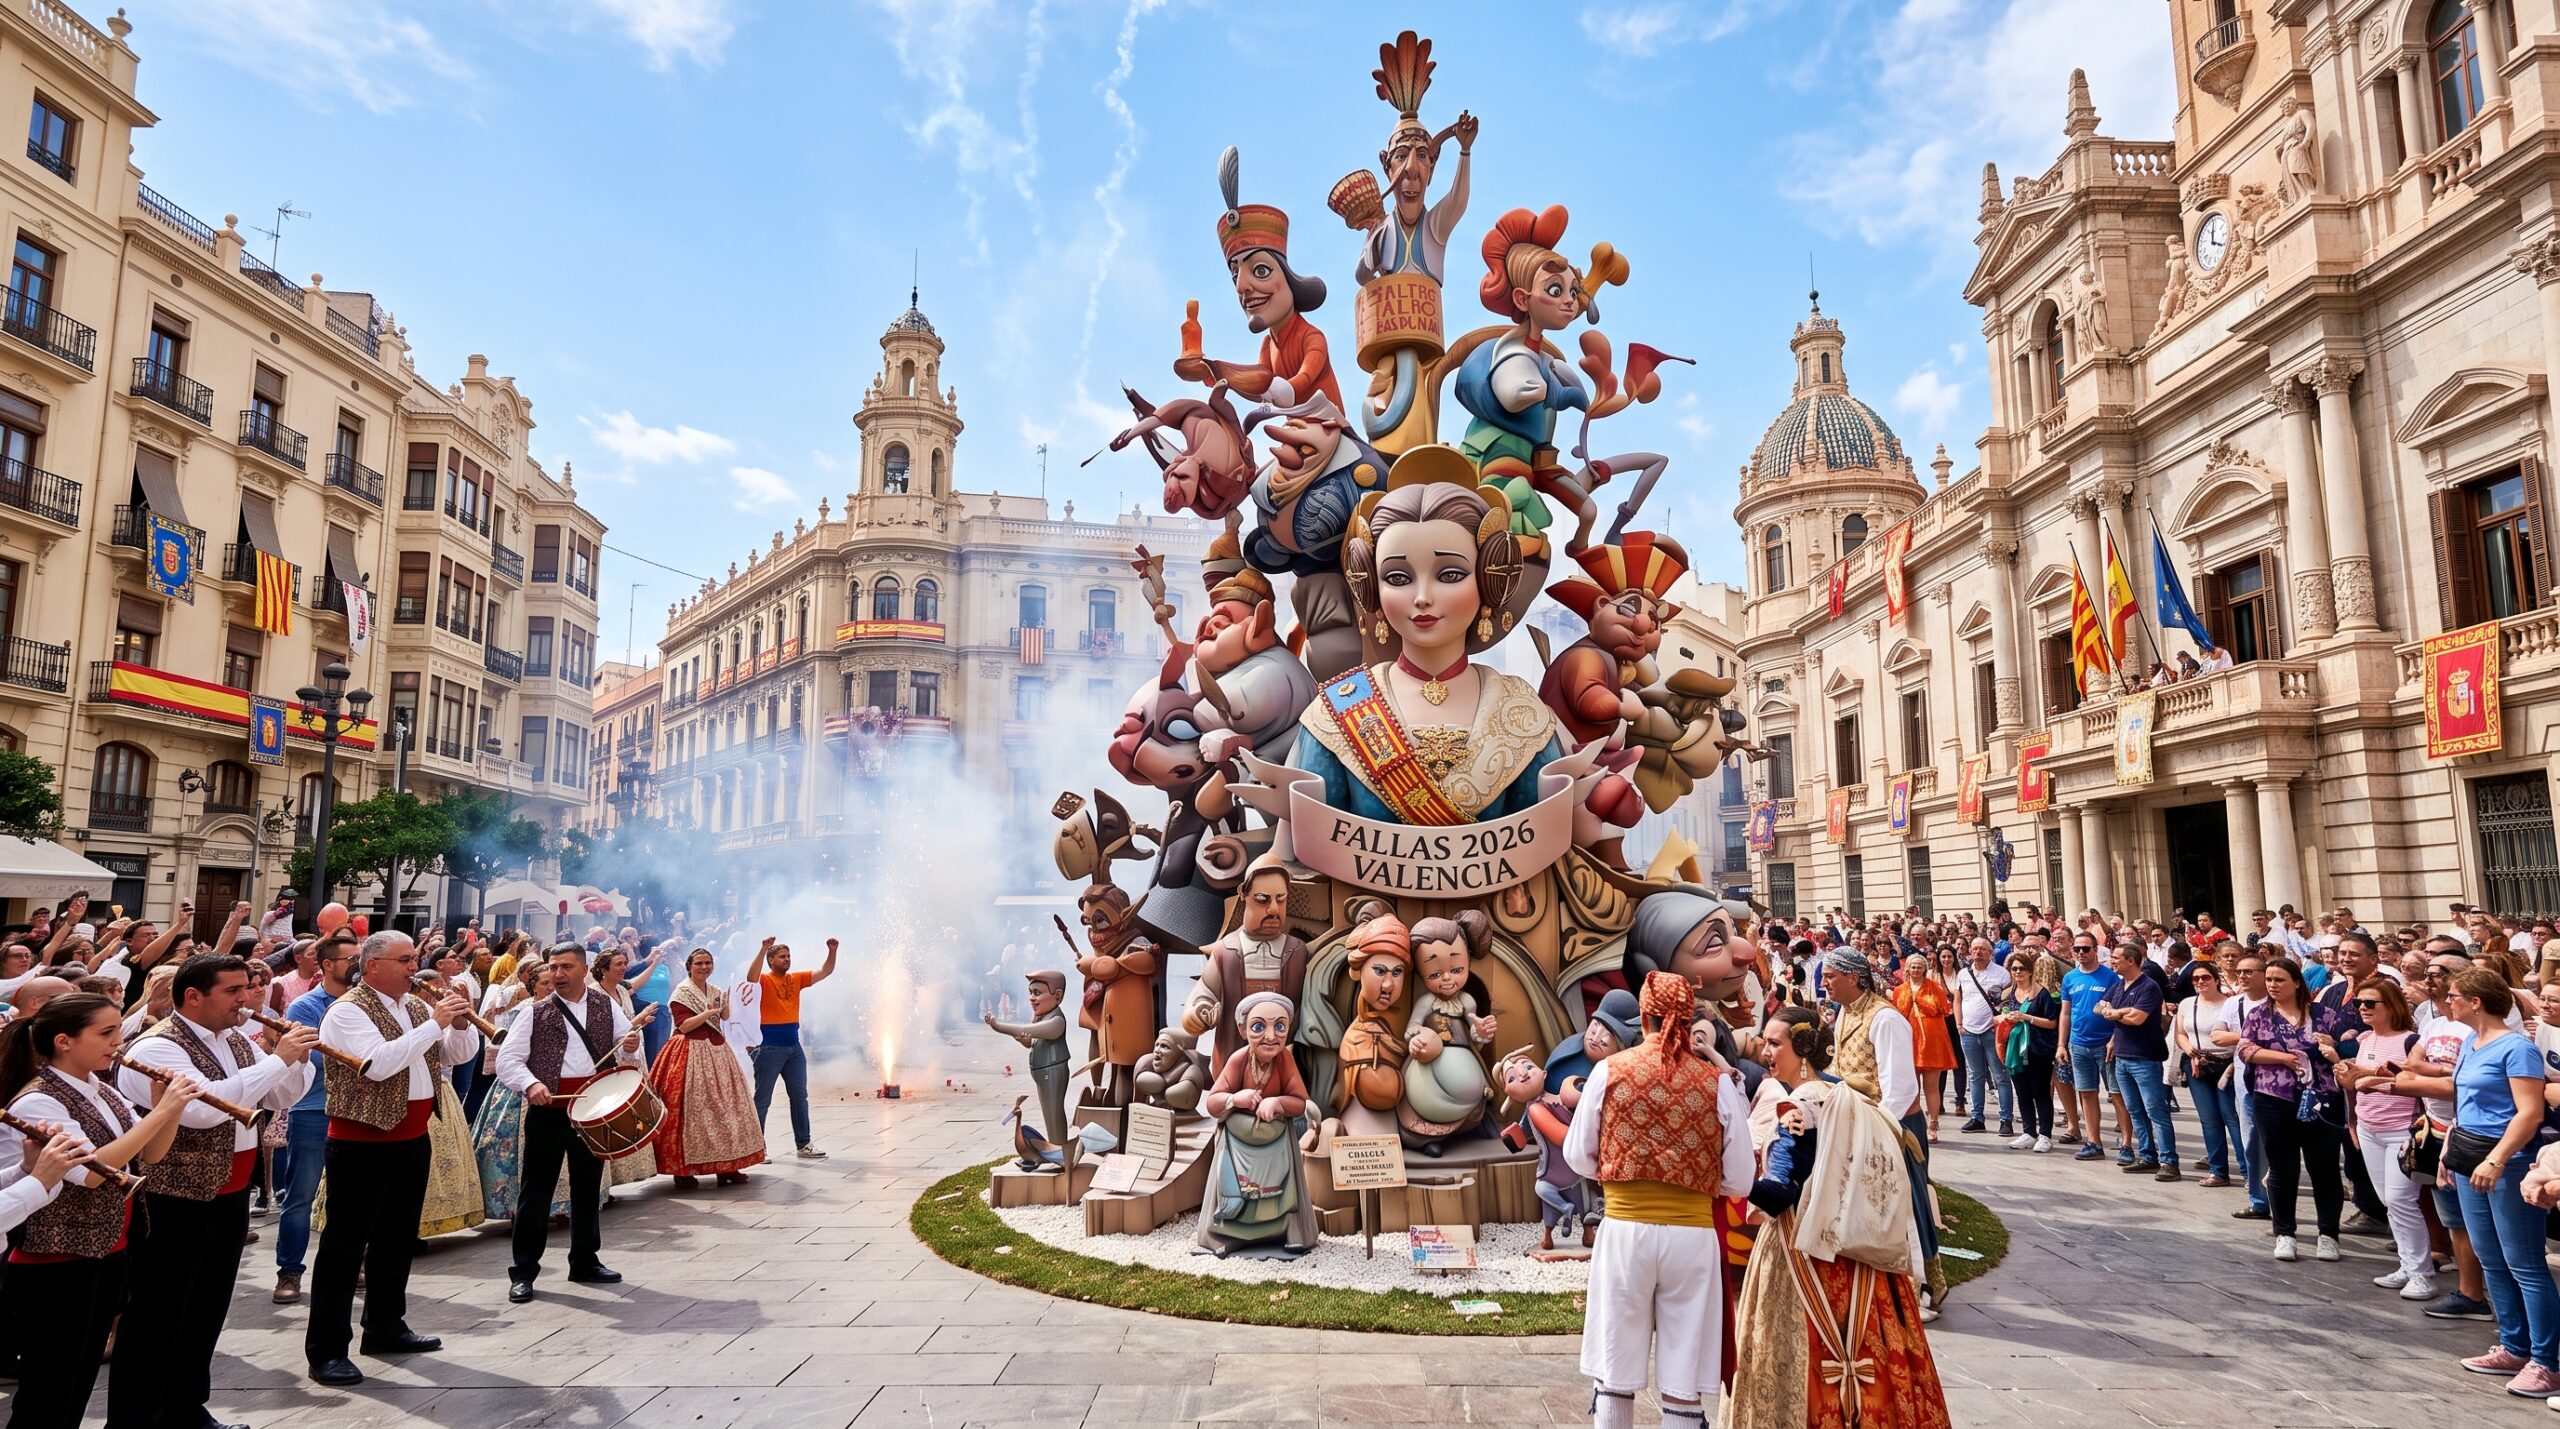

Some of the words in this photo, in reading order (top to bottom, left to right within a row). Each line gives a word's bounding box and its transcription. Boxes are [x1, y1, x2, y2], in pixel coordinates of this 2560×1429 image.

[1330, 818, 1451, 860] FALLAS
[1461, 819, 1536, 859] 2026
[1353, 854, 1518, 890] VALENCIA
